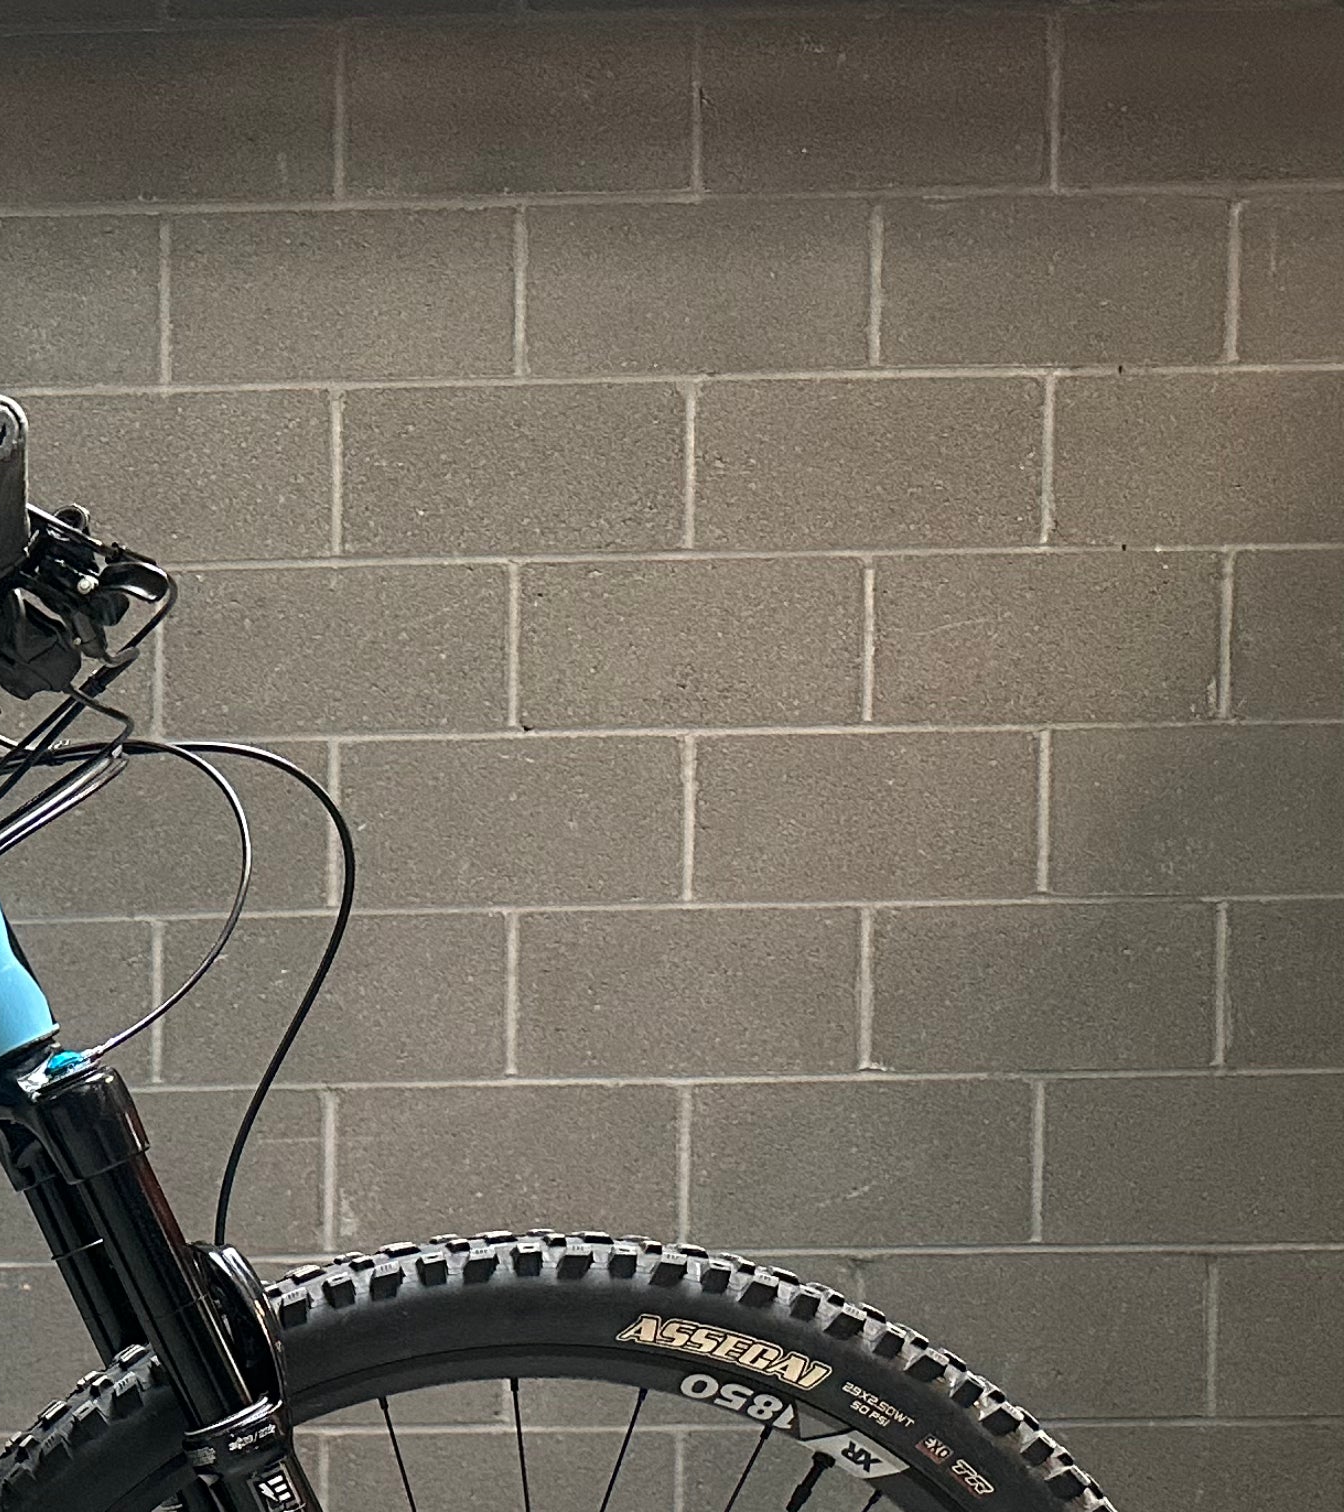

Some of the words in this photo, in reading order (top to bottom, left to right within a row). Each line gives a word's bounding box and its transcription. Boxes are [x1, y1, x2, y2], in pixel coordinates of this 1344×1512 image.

[615, 1313, 833, 1391] ASSEGAI
[679, 1372, 796, 1430] 1850
[868, 1409, 891, 1428] PSI
[840, 1440, 883, 1473] XR
